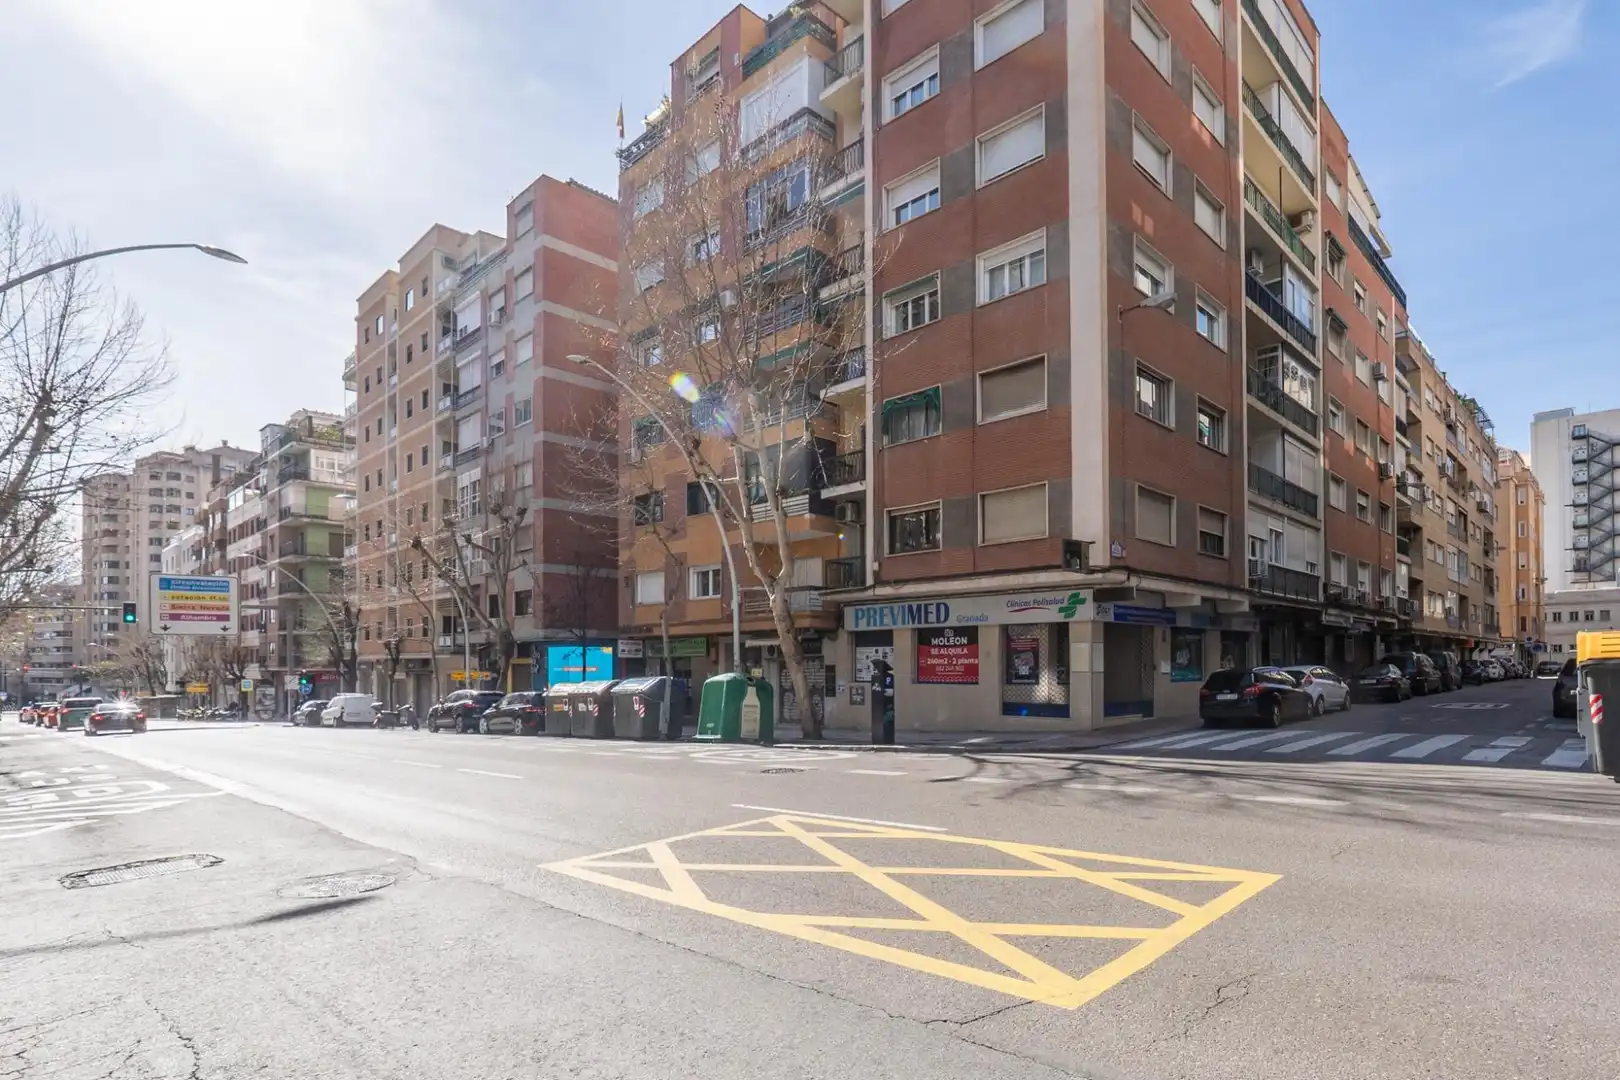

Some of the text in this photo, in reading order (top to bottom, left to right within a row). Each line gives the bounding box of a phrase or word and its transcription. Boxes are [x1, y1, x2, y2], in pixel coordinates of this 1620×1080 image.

[854, 602, 950, 628] PREVIMED
[956, 613, 989, 624] Granada
[940, 648, 969, 656] ALQUILA
